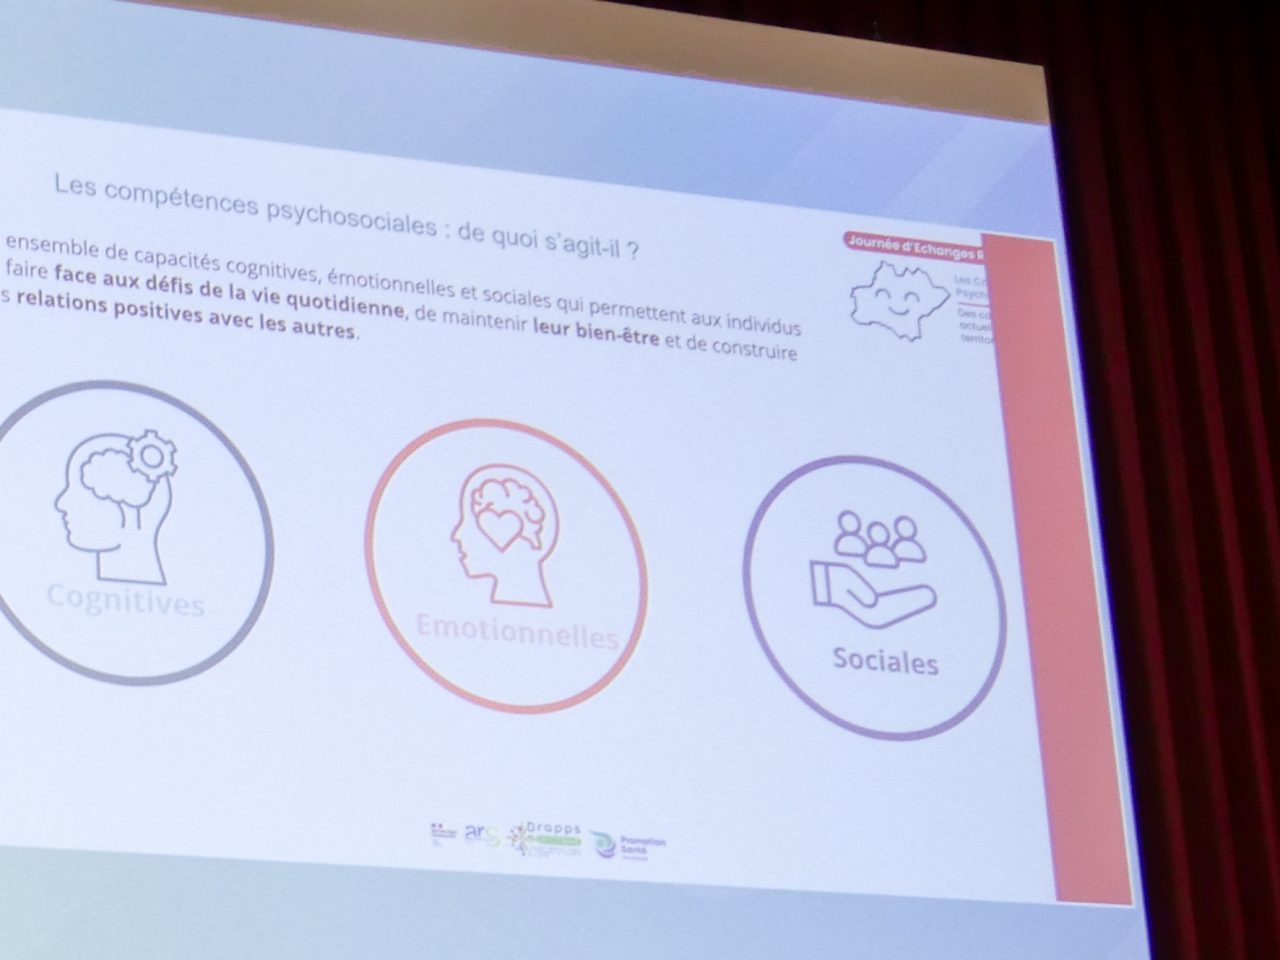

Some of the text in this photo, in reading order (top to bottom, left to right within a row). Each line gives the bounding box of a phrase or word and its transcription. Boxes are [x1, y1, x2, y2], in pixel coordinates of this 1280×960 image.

[55, 172, 97, 197] Les
[105, 182, 259, 216] compétences
[267, 202, 438, 236] psychosociales
[458, 222, 484, 242] de
[492, 228, 539, 250] quoi
[627, 241, 639, 260] ?
[848, 235, 901, 250] Journée
[5, 234, 100, 258] ensemble
[105, 243, 128, 261] de
[134, 249, 221, 272] capacités
[226, 258, 322, 285] cognitives,
[327, 268, 456, 298] émotionnelles
[460, 284, 478, 301] et
[483, 287, 552, 309] sociales
[557, 295, 584, 315] qui
[589, 300, 687, 325] permettent
[691, 312, 722, 328] aux
[726, 313, 802, 337] individus
[6, 258, 48, 279] faire
[54, 264, 97, 284] face
[103, 272, 140, 289] aux
[146, 275, 194, 296] défis
[200, 280, 222, 298] de
[229, 283, 246, 301] la
[252, 286, 281, 304] vie
[286, 292, 410, 322] quotidienne,
[415, 304, 437, 323] de
[442, 310, 528, 332] maintenir
[533, 317, 570, 336] leur
[576, 321, 660, 347] bien-être
[665, 334, 682, 350] et
[686, 336, 707, 352] de
[712, 340, 798, 362] construire
[17, 290, 108, 313] relations
[114, 300, 203, 324] positives
[209, 312, 254, 329] avec
[260, 313, 287, 333] les
[292, 320, 360, 341] autres.
[47, 583, 206, 617] Cognitives
[416, 613, 619, 650] Emotionnelles
[833, 647, 939, 676] Sociales
